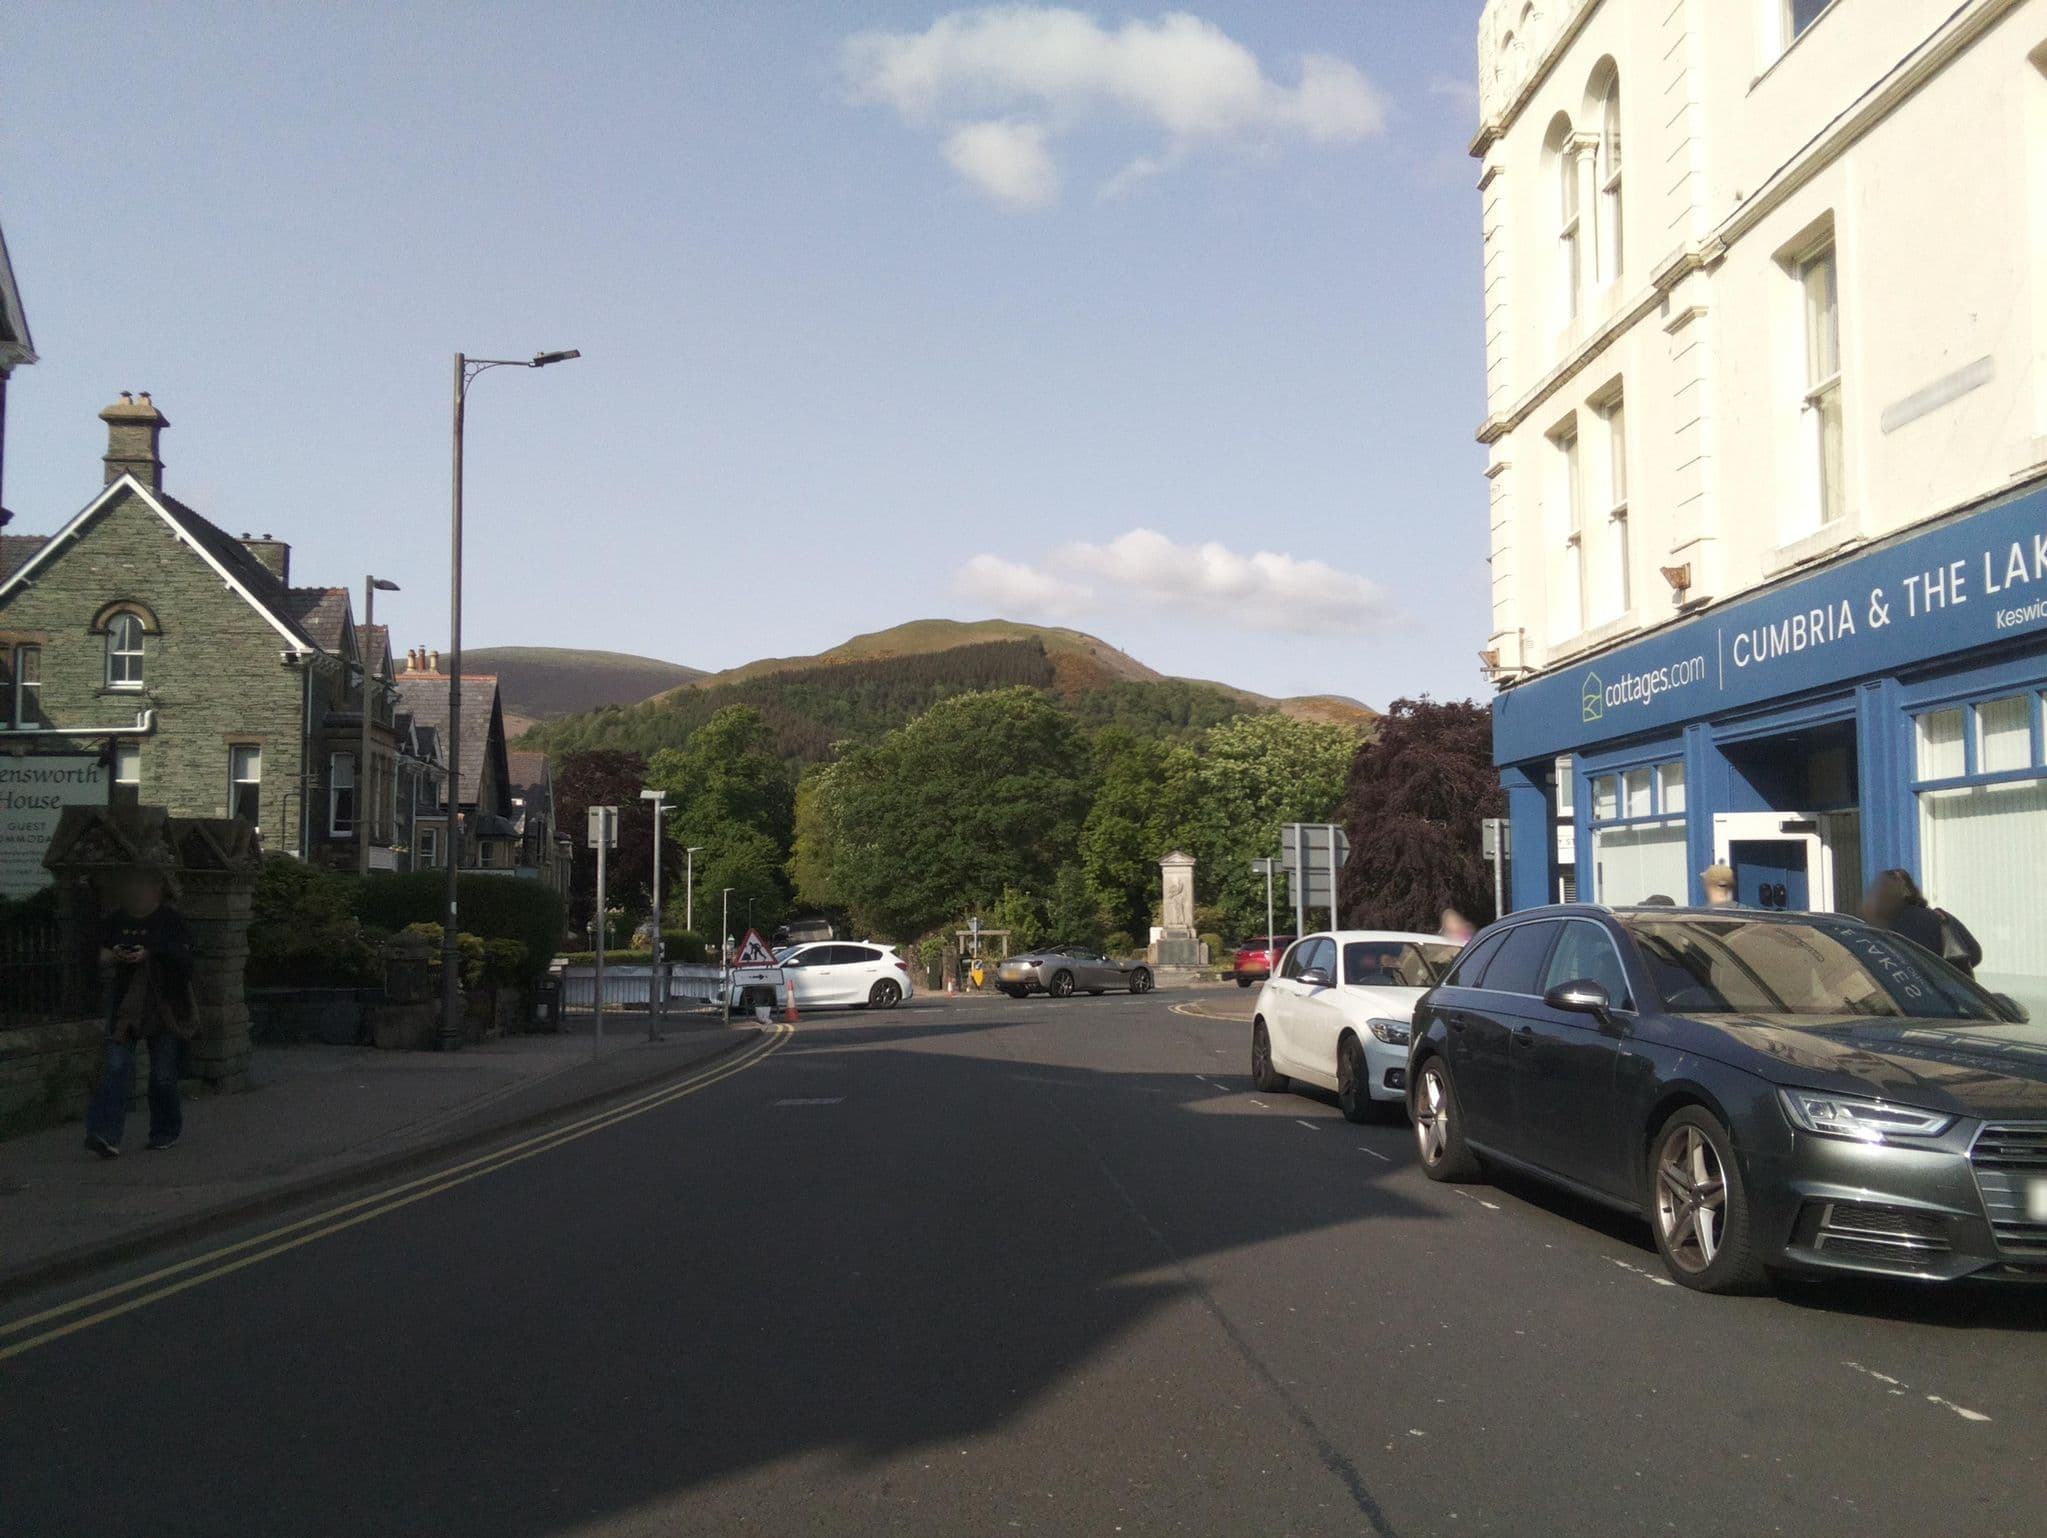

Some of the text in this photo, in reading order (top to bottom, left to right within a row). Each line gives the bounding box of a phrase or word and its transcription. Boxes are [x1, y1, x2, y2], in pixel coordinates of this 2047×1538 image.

[1605, 655, 1705, 707] cottages.com
[1733, 599, 1856, 667] CUMBRIA
[1868, 588, 1891, 629] &
[1903, 559, 1967, 617] THE
[8, 822, 46, 831] GUEST
